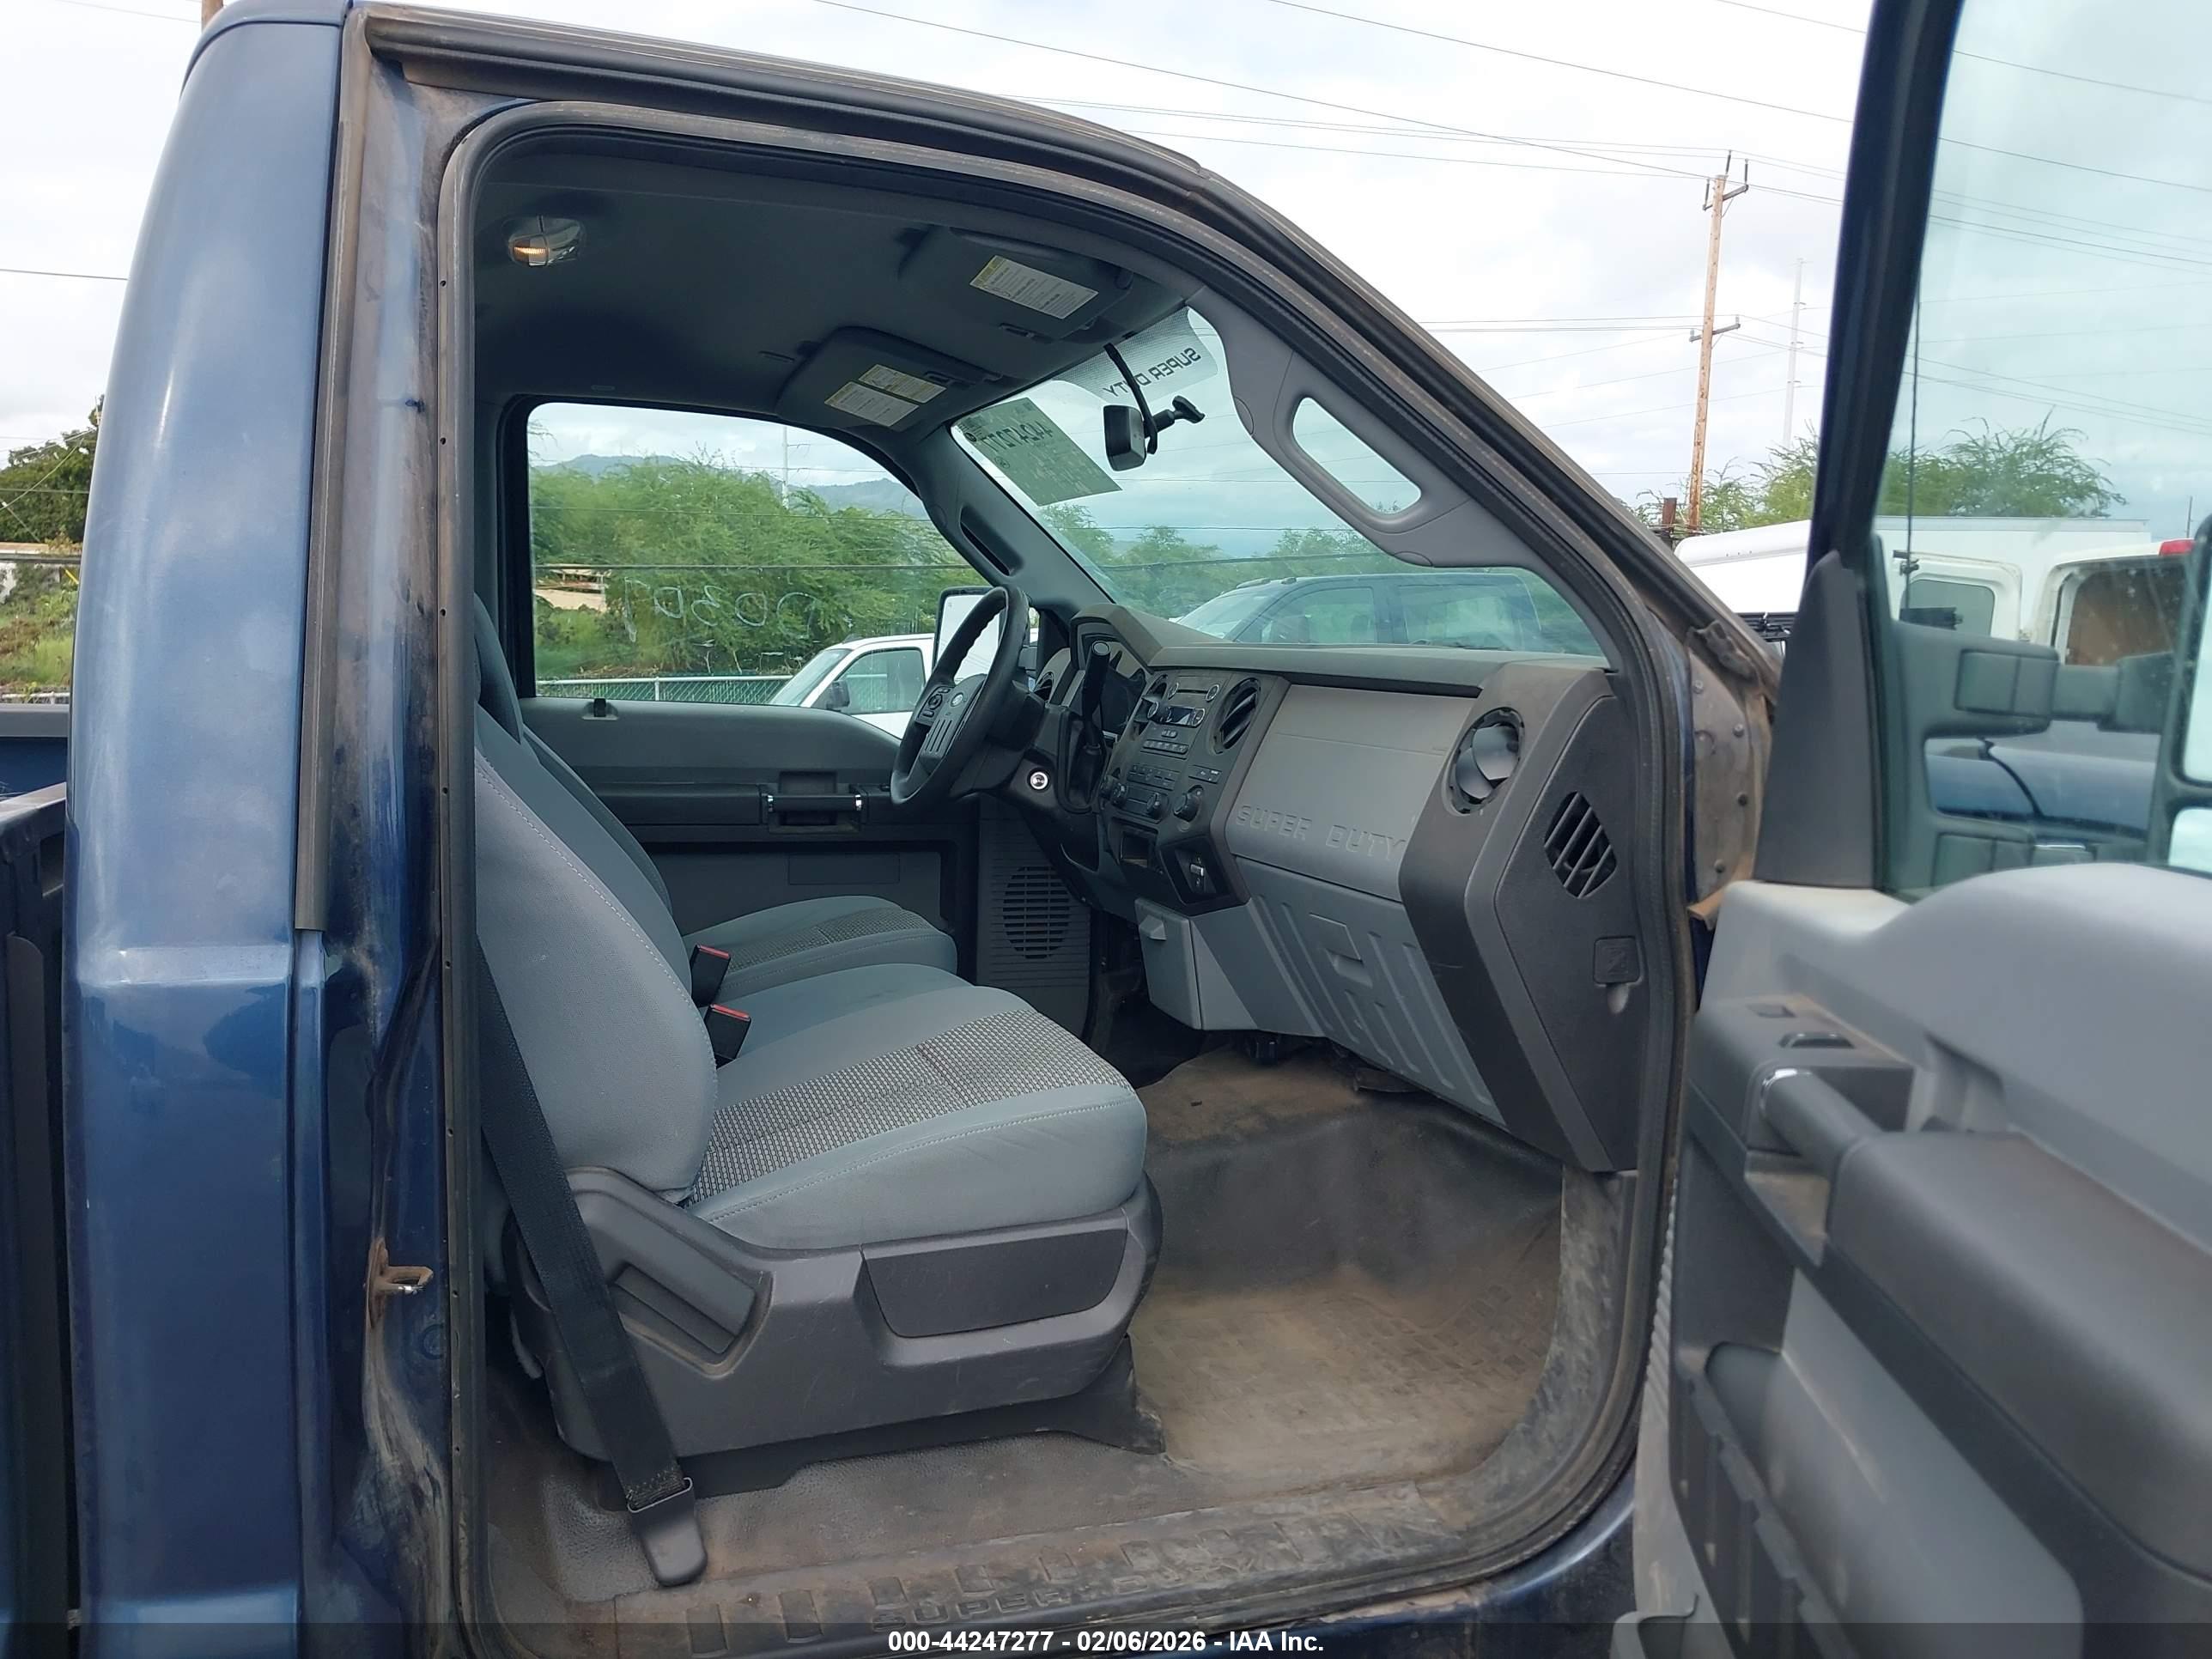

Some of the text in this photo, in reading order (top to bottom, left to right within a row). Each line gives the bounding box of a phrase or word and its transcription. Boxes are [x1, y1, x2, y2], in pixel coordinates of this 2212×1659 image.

[1236, 804, 1407, 861] SUPER DUTY
[871, 1589, 1073, 1632] SUPER
